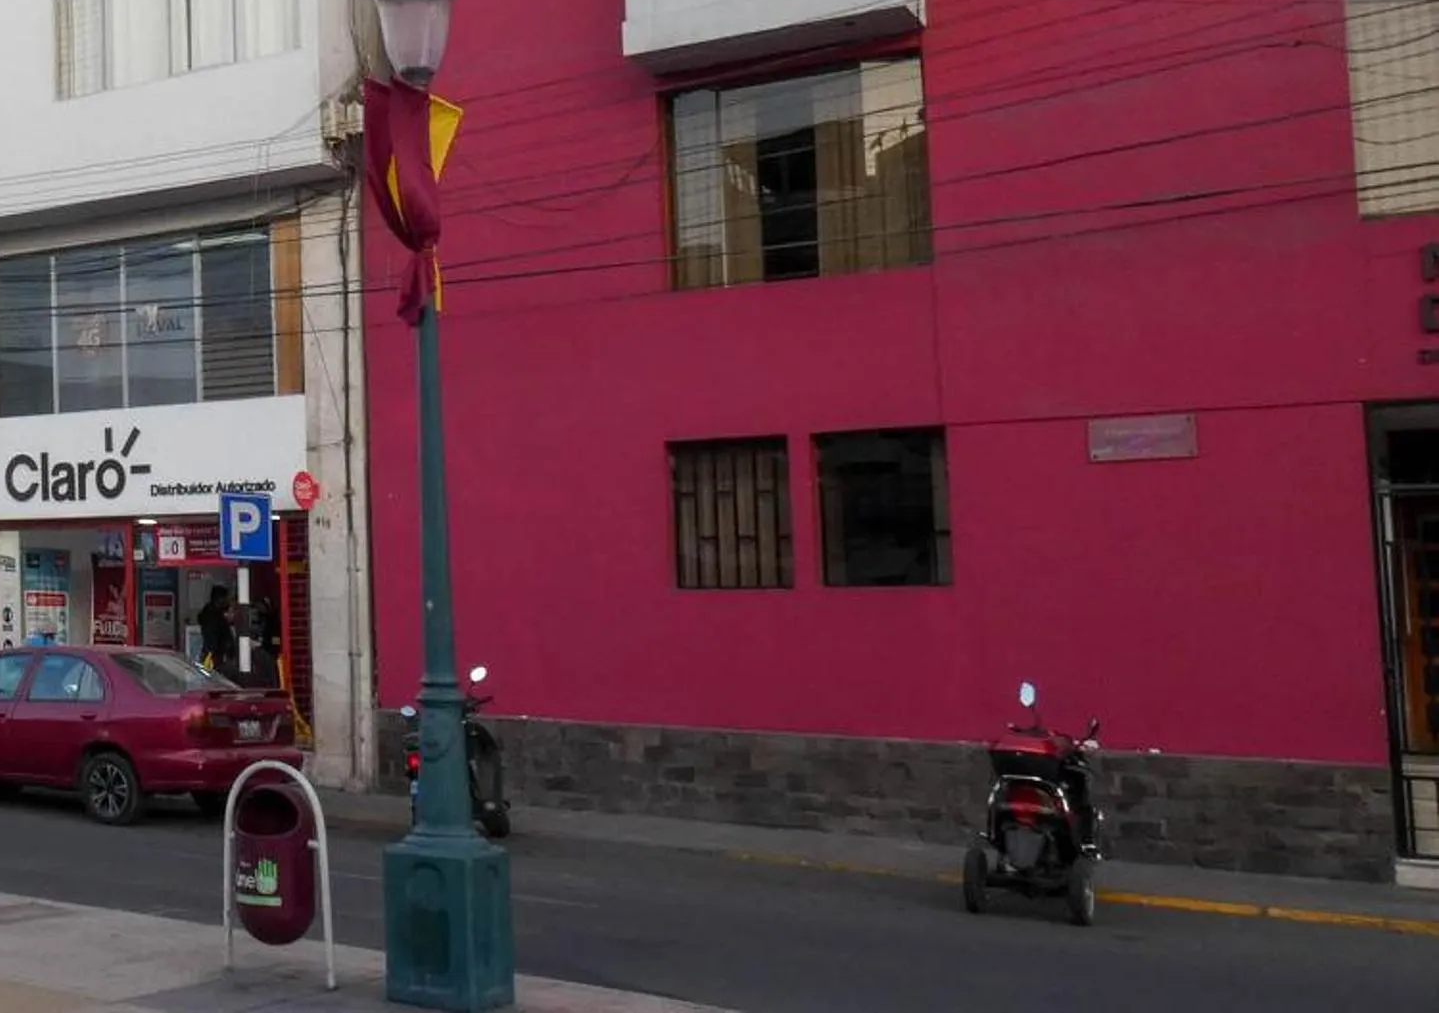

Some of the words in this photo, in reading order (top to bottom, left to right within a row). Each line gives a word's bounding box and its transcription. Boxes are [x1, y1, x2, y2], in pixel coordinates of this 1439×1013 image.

[5, 451, 127, 503] Claro
[150, 481, 214, 498] Distribuidor
[215, 478, 276, 494] Autorizado
[229, 500, 261, 551] P
